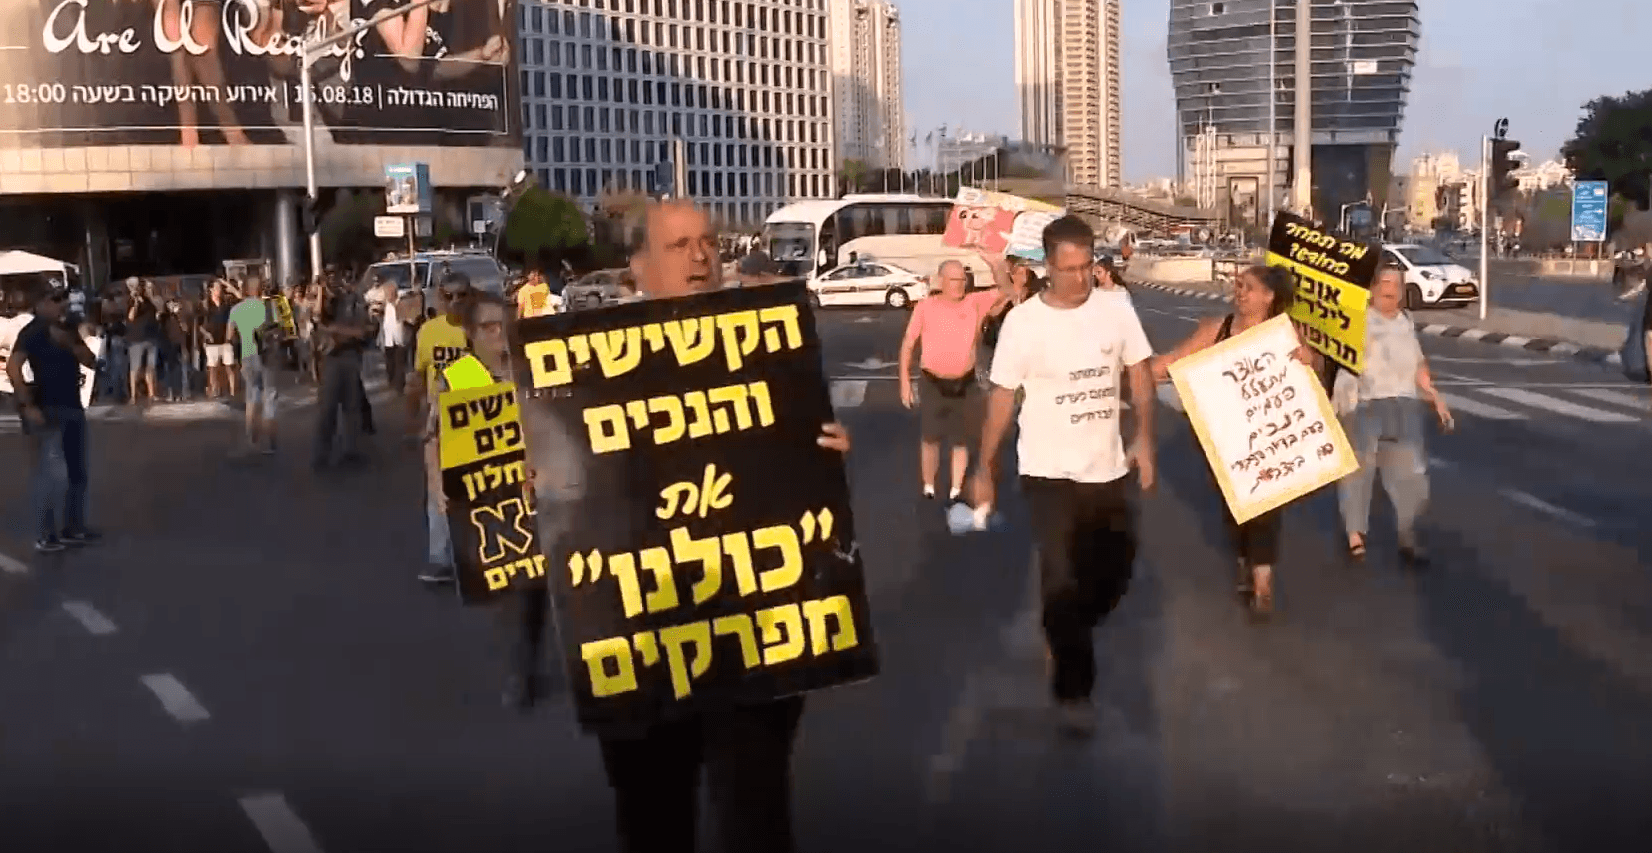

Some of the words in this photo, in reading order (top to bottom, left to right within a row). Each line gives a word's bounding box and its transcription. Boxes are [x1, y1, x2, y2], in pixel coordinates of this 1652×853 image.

[42, 0, 141, 54] Are
[3, 83, 65, 104] 18:00
[72, 84, 135, 103] בשעה
[141, 83, 220, 107] ההשקה
[226, 84, 277, 104] אירוע
[386, 87, 444, 106] הגדולה
[446, 92, 498, 112] הפתיחה
[525, 304, 803, 389] הקשישים
[1222, 352, 1276, 383] האוצר
[448, 390, 516, 430] ישים
[583, 381, 775, 454] והנכים
[474, 421, 521, 455] כים
[655, 463, 734, 520] את
[581, 594, 859, 701] מפרקים
